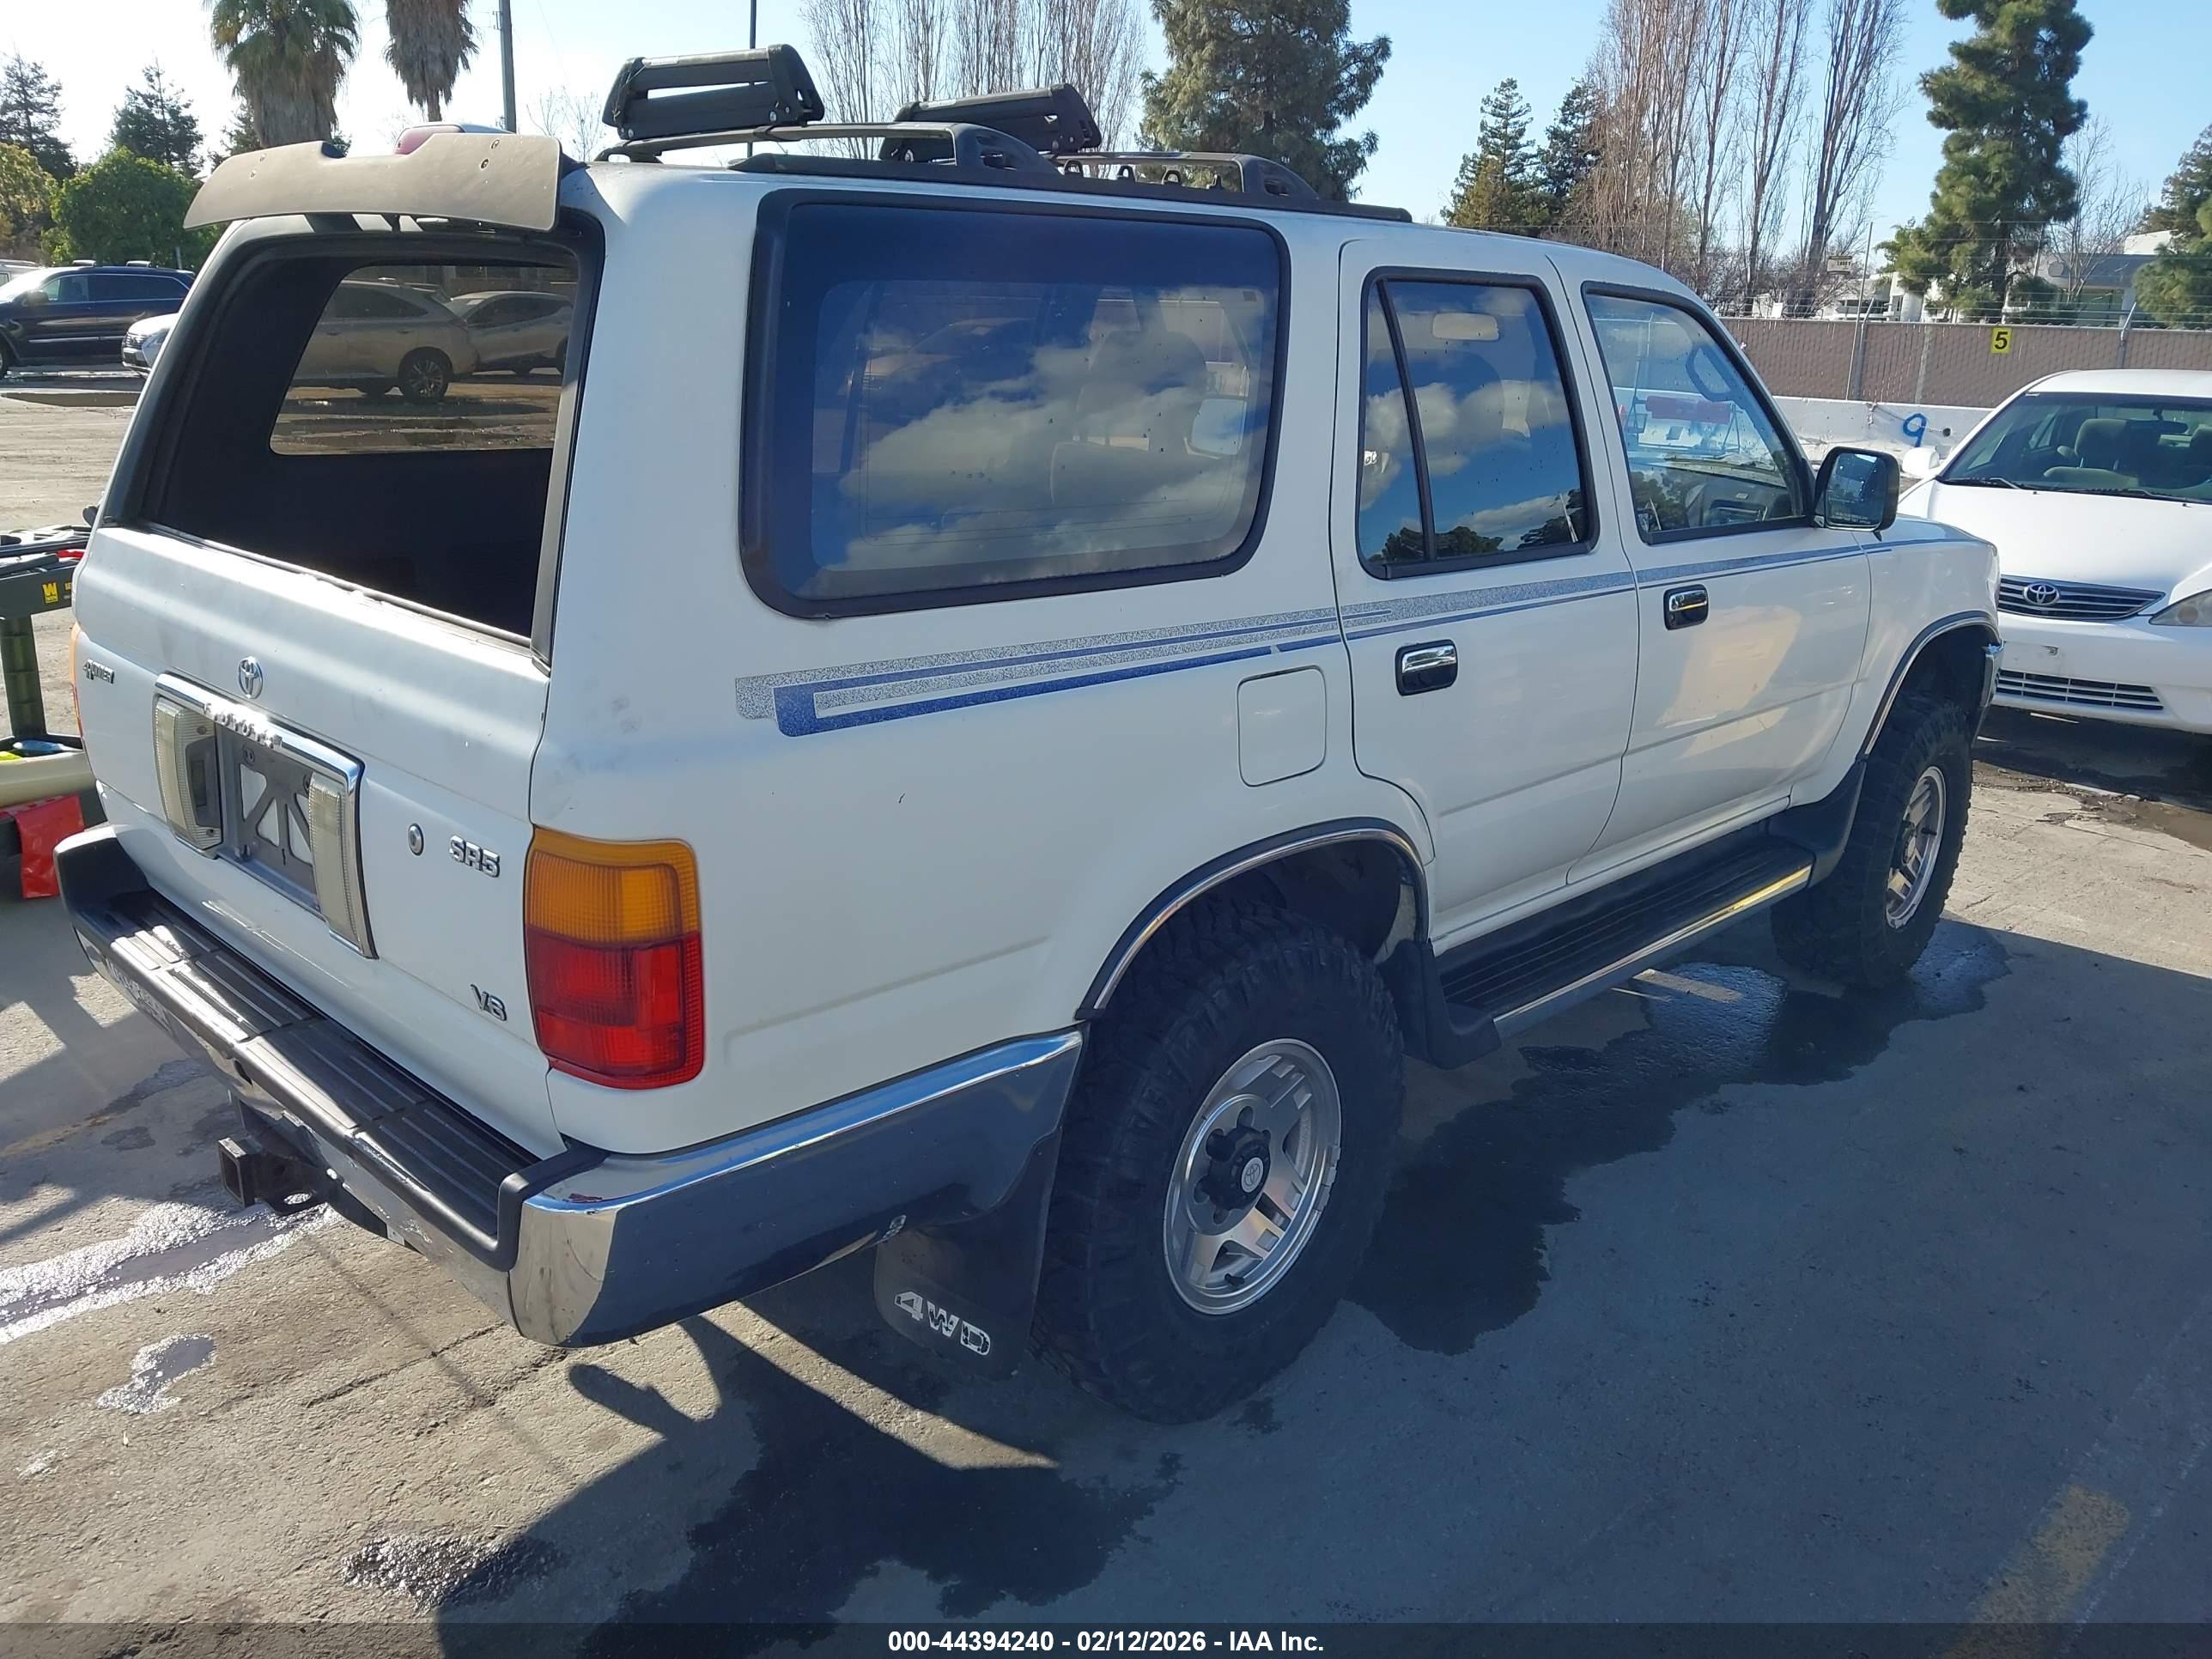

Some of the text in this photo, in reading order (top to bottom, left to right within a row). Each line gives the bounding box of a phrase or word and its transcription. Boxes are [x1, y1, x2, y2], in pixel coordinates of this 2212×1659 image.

[1994, 331, 2008, 350] 5
[1902, 413, 1927, 447] 9
[449, 836, 500, 878] SR5
[470, 983, 507, 1021] V6
[895, 1291, 991, 1356] 4WD
